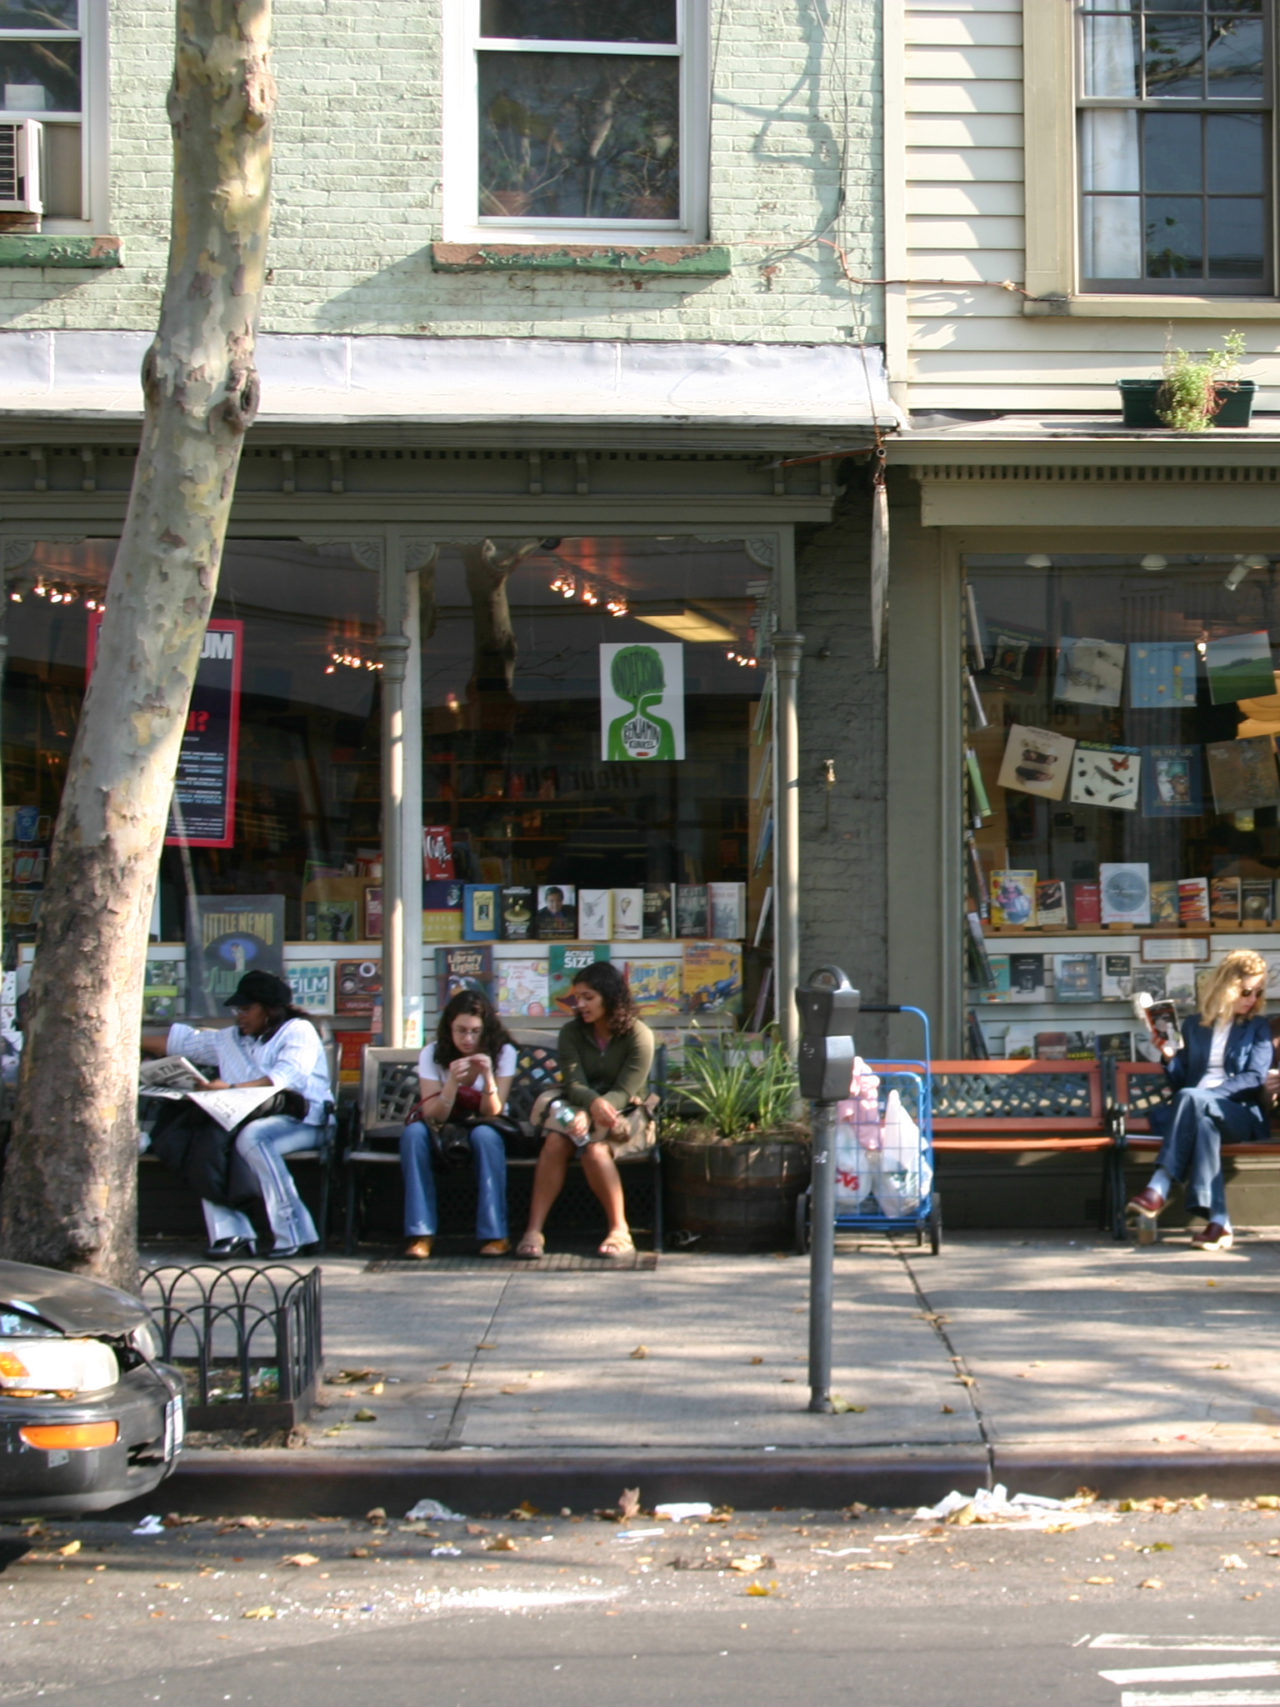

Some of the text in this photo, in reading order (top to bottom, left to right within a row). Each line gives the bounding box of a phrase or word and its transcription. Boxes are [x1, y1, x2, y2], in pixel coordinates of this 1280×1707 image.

[203, 912, 275, 949] LITTLE NEMO
[563, 959, 595, 969] SIZE
[289, 975, 329, 993] FILM
